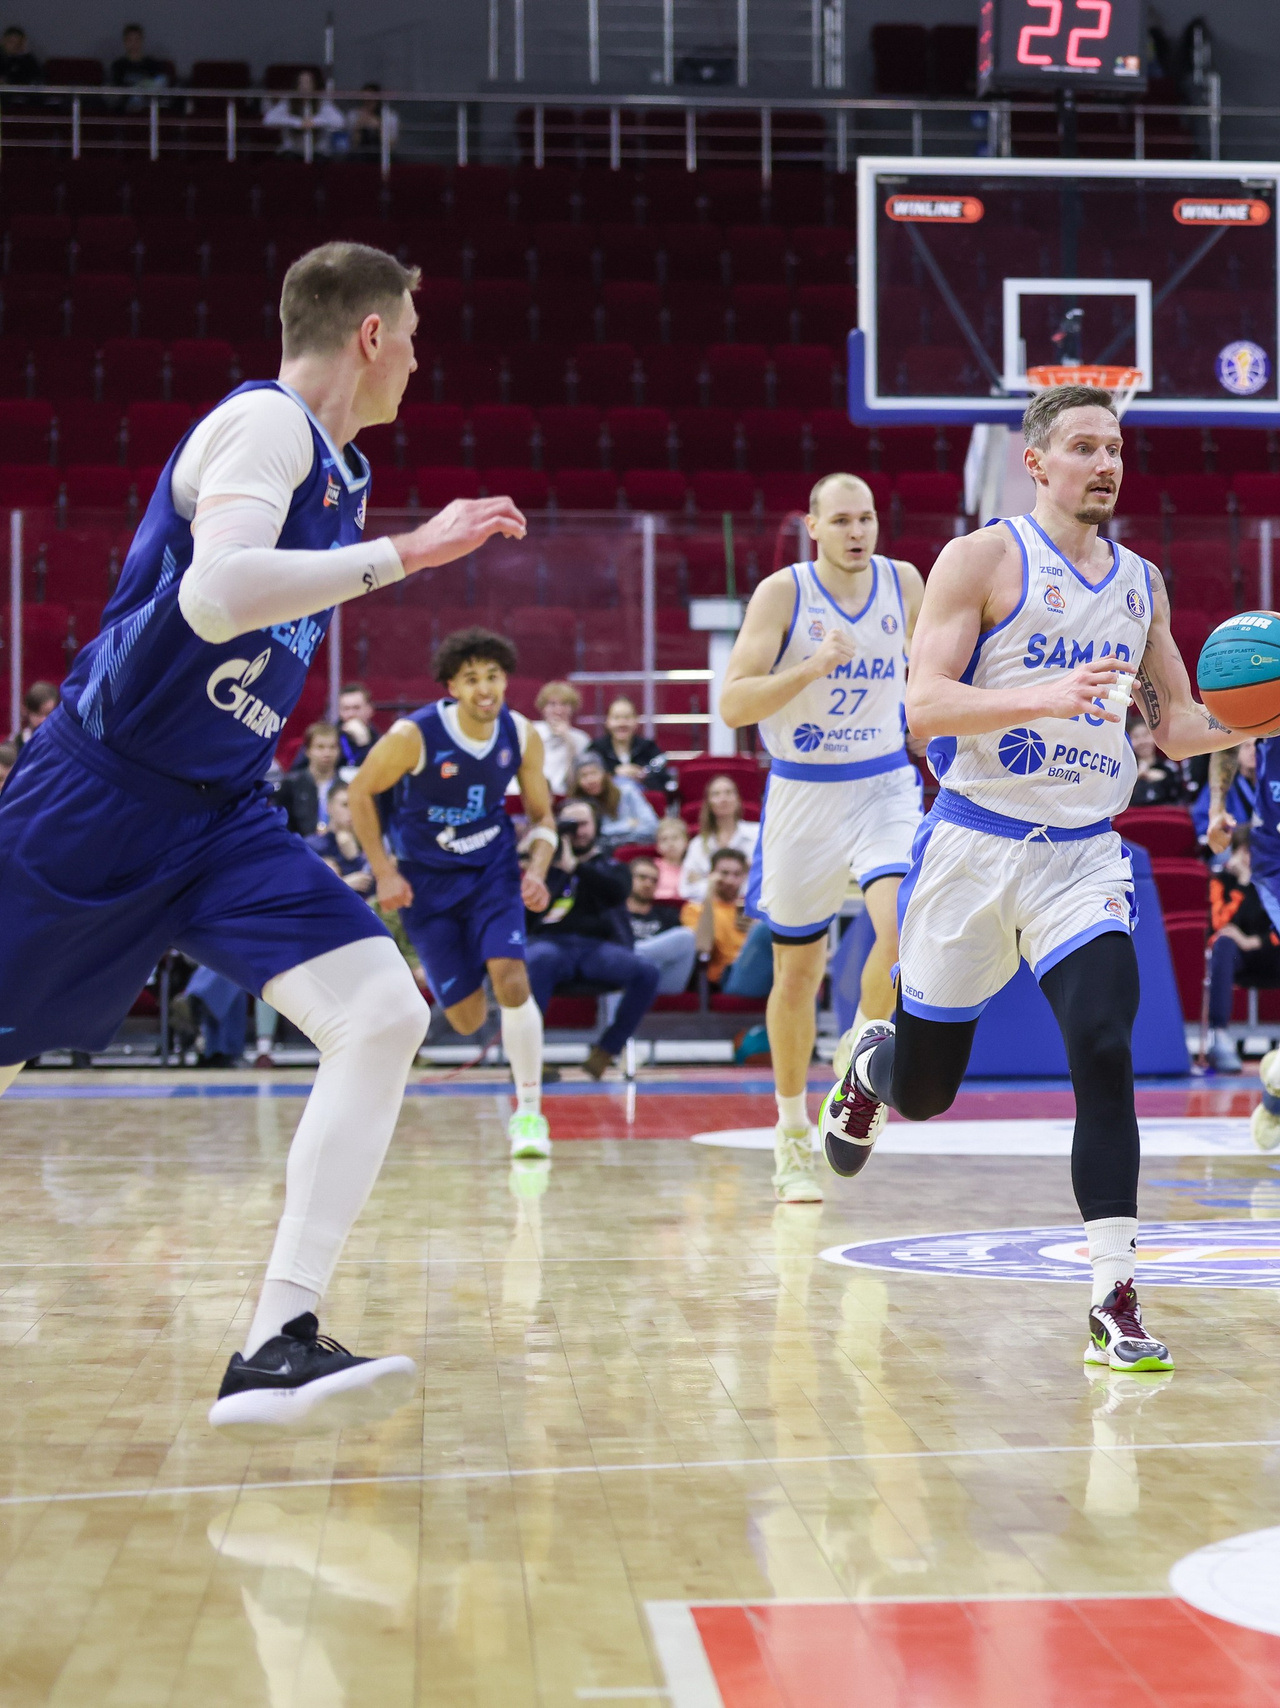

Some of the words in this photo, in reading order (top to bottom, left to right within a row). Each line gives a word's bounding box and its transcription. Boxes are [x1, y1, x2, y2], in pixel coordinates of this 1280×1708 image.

[1016, 0, 1112, 67] 22
[892, 200, 962, 218] WINLINE
[1180, 203, 1250, 221] WINLINE
[1040, 566, 1063, 577] ZEDO
[1023, 632, 1136, 675] SAMAR
[828, 678, 868, 715] 27
[1052, 743, 1122, 780] РОССЕТИ
[1048, 767, 1081, 784] ВОЛГА
[905, 984, 924, 1000] ZEDO
